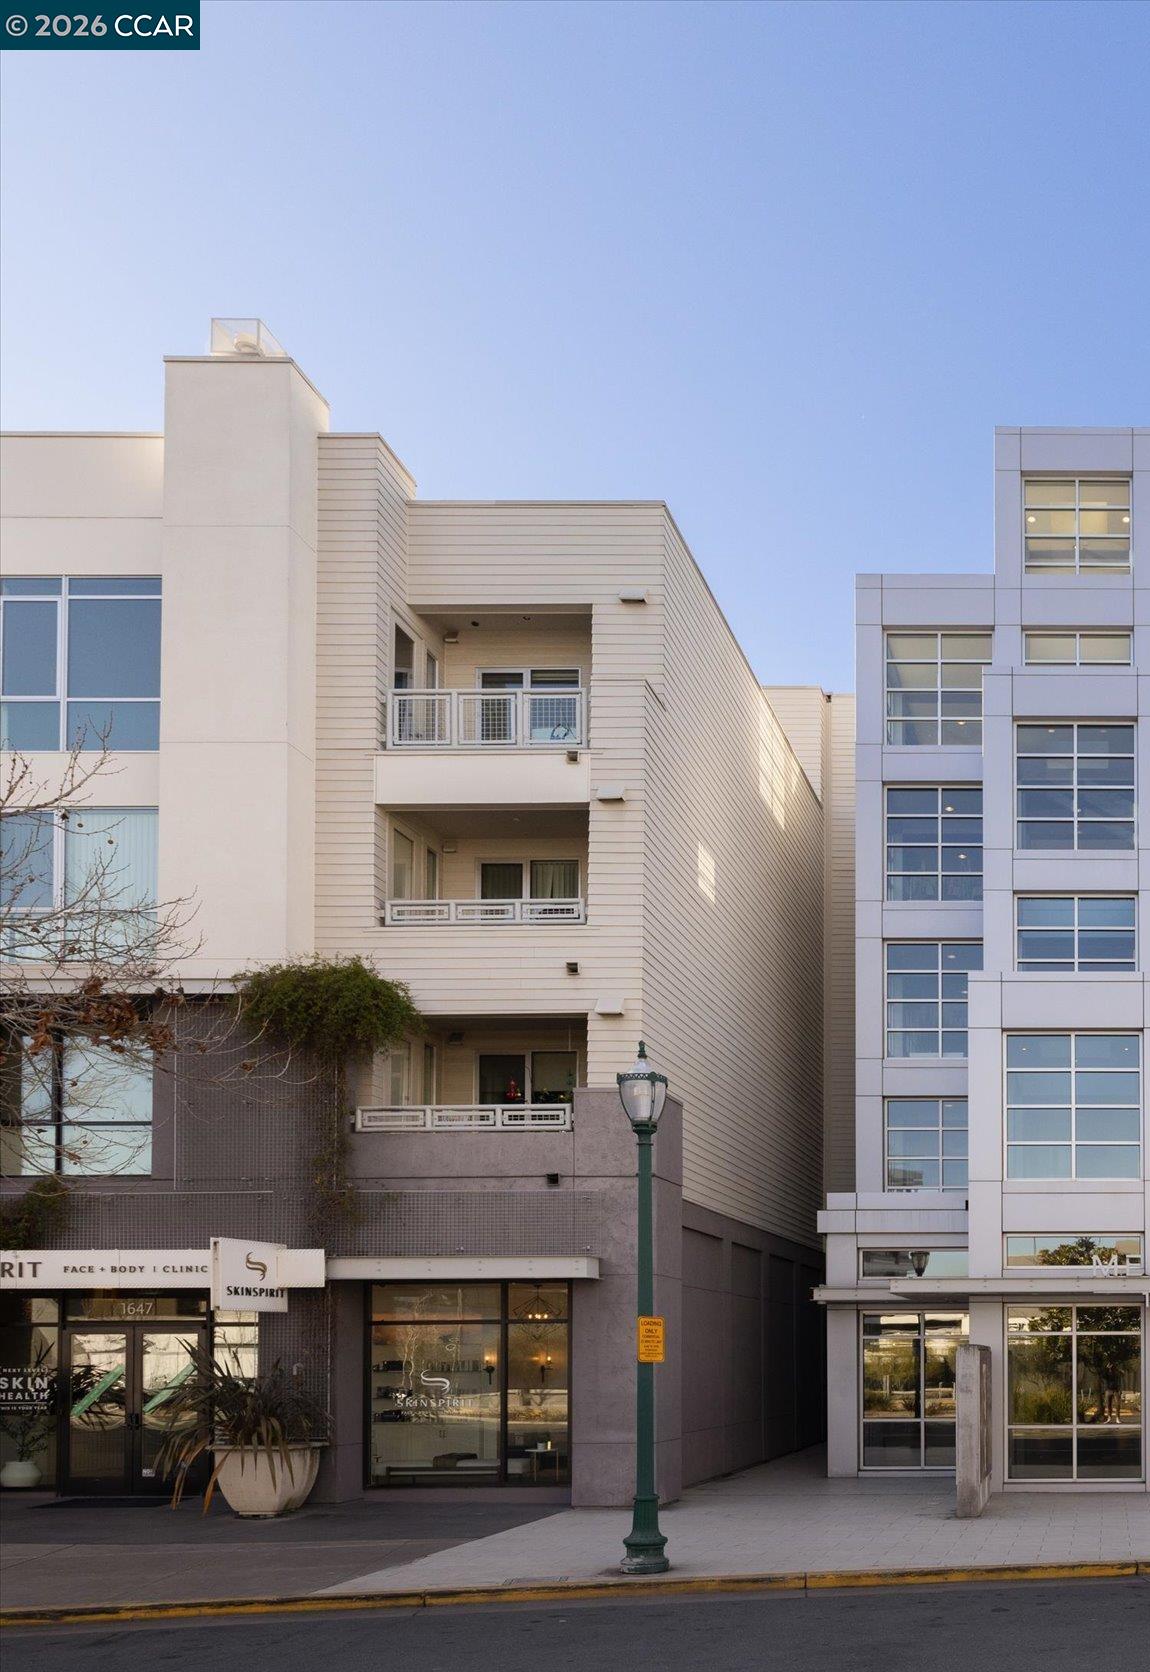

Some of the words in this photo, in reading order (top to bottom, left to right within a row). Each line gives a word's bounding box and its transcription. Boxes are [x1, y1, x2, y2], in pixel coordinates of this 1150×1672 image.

[63, 1265, 95, 1273] FACE
[110, 1265, 145, 1273] BODY
[162, 1265, 208, 1273] CLINIC
[227, 1285, 285, 1298] SKINSPIRIT
[121, 1302, 153, 1315] 1647
[0, 1377, 48, 1389] SKIN
[0, 1392, 48, 1400] HEALTH
[396, 1398, 473, 1407] SKINSPIRIT
